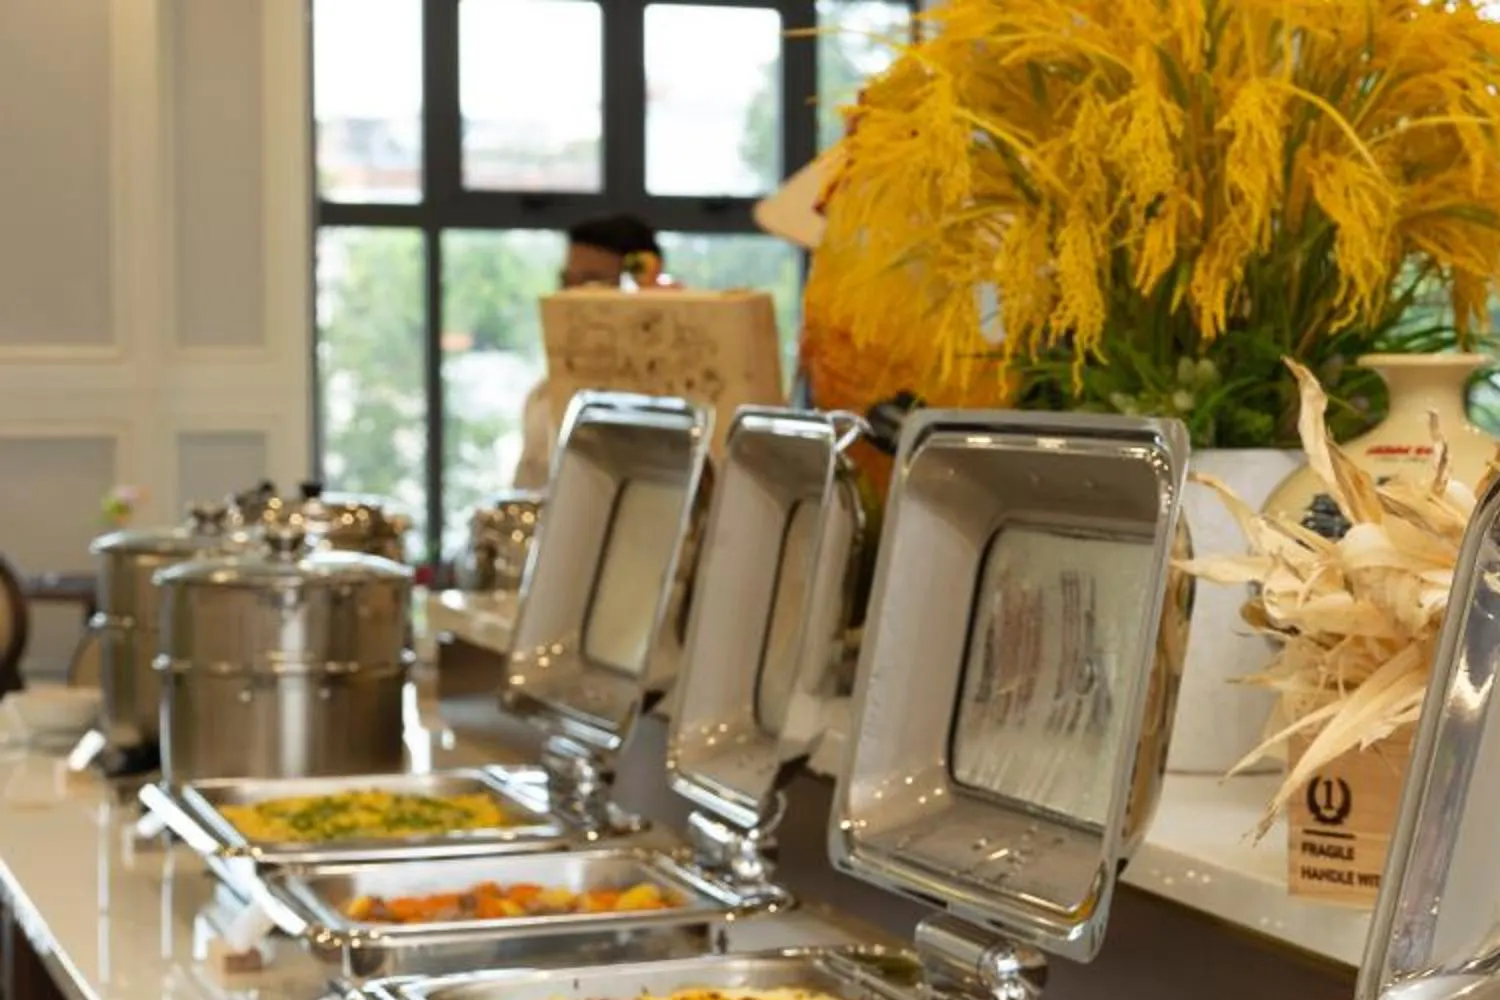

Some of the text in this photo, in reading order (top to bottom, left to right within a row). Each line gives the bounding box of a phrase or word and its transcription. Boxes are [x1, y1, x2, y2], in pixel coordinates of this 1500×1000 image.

[1301, 841, 1355, 861] FRAGILE
[1301, 865, 1381, 888] HANDLE WIT
